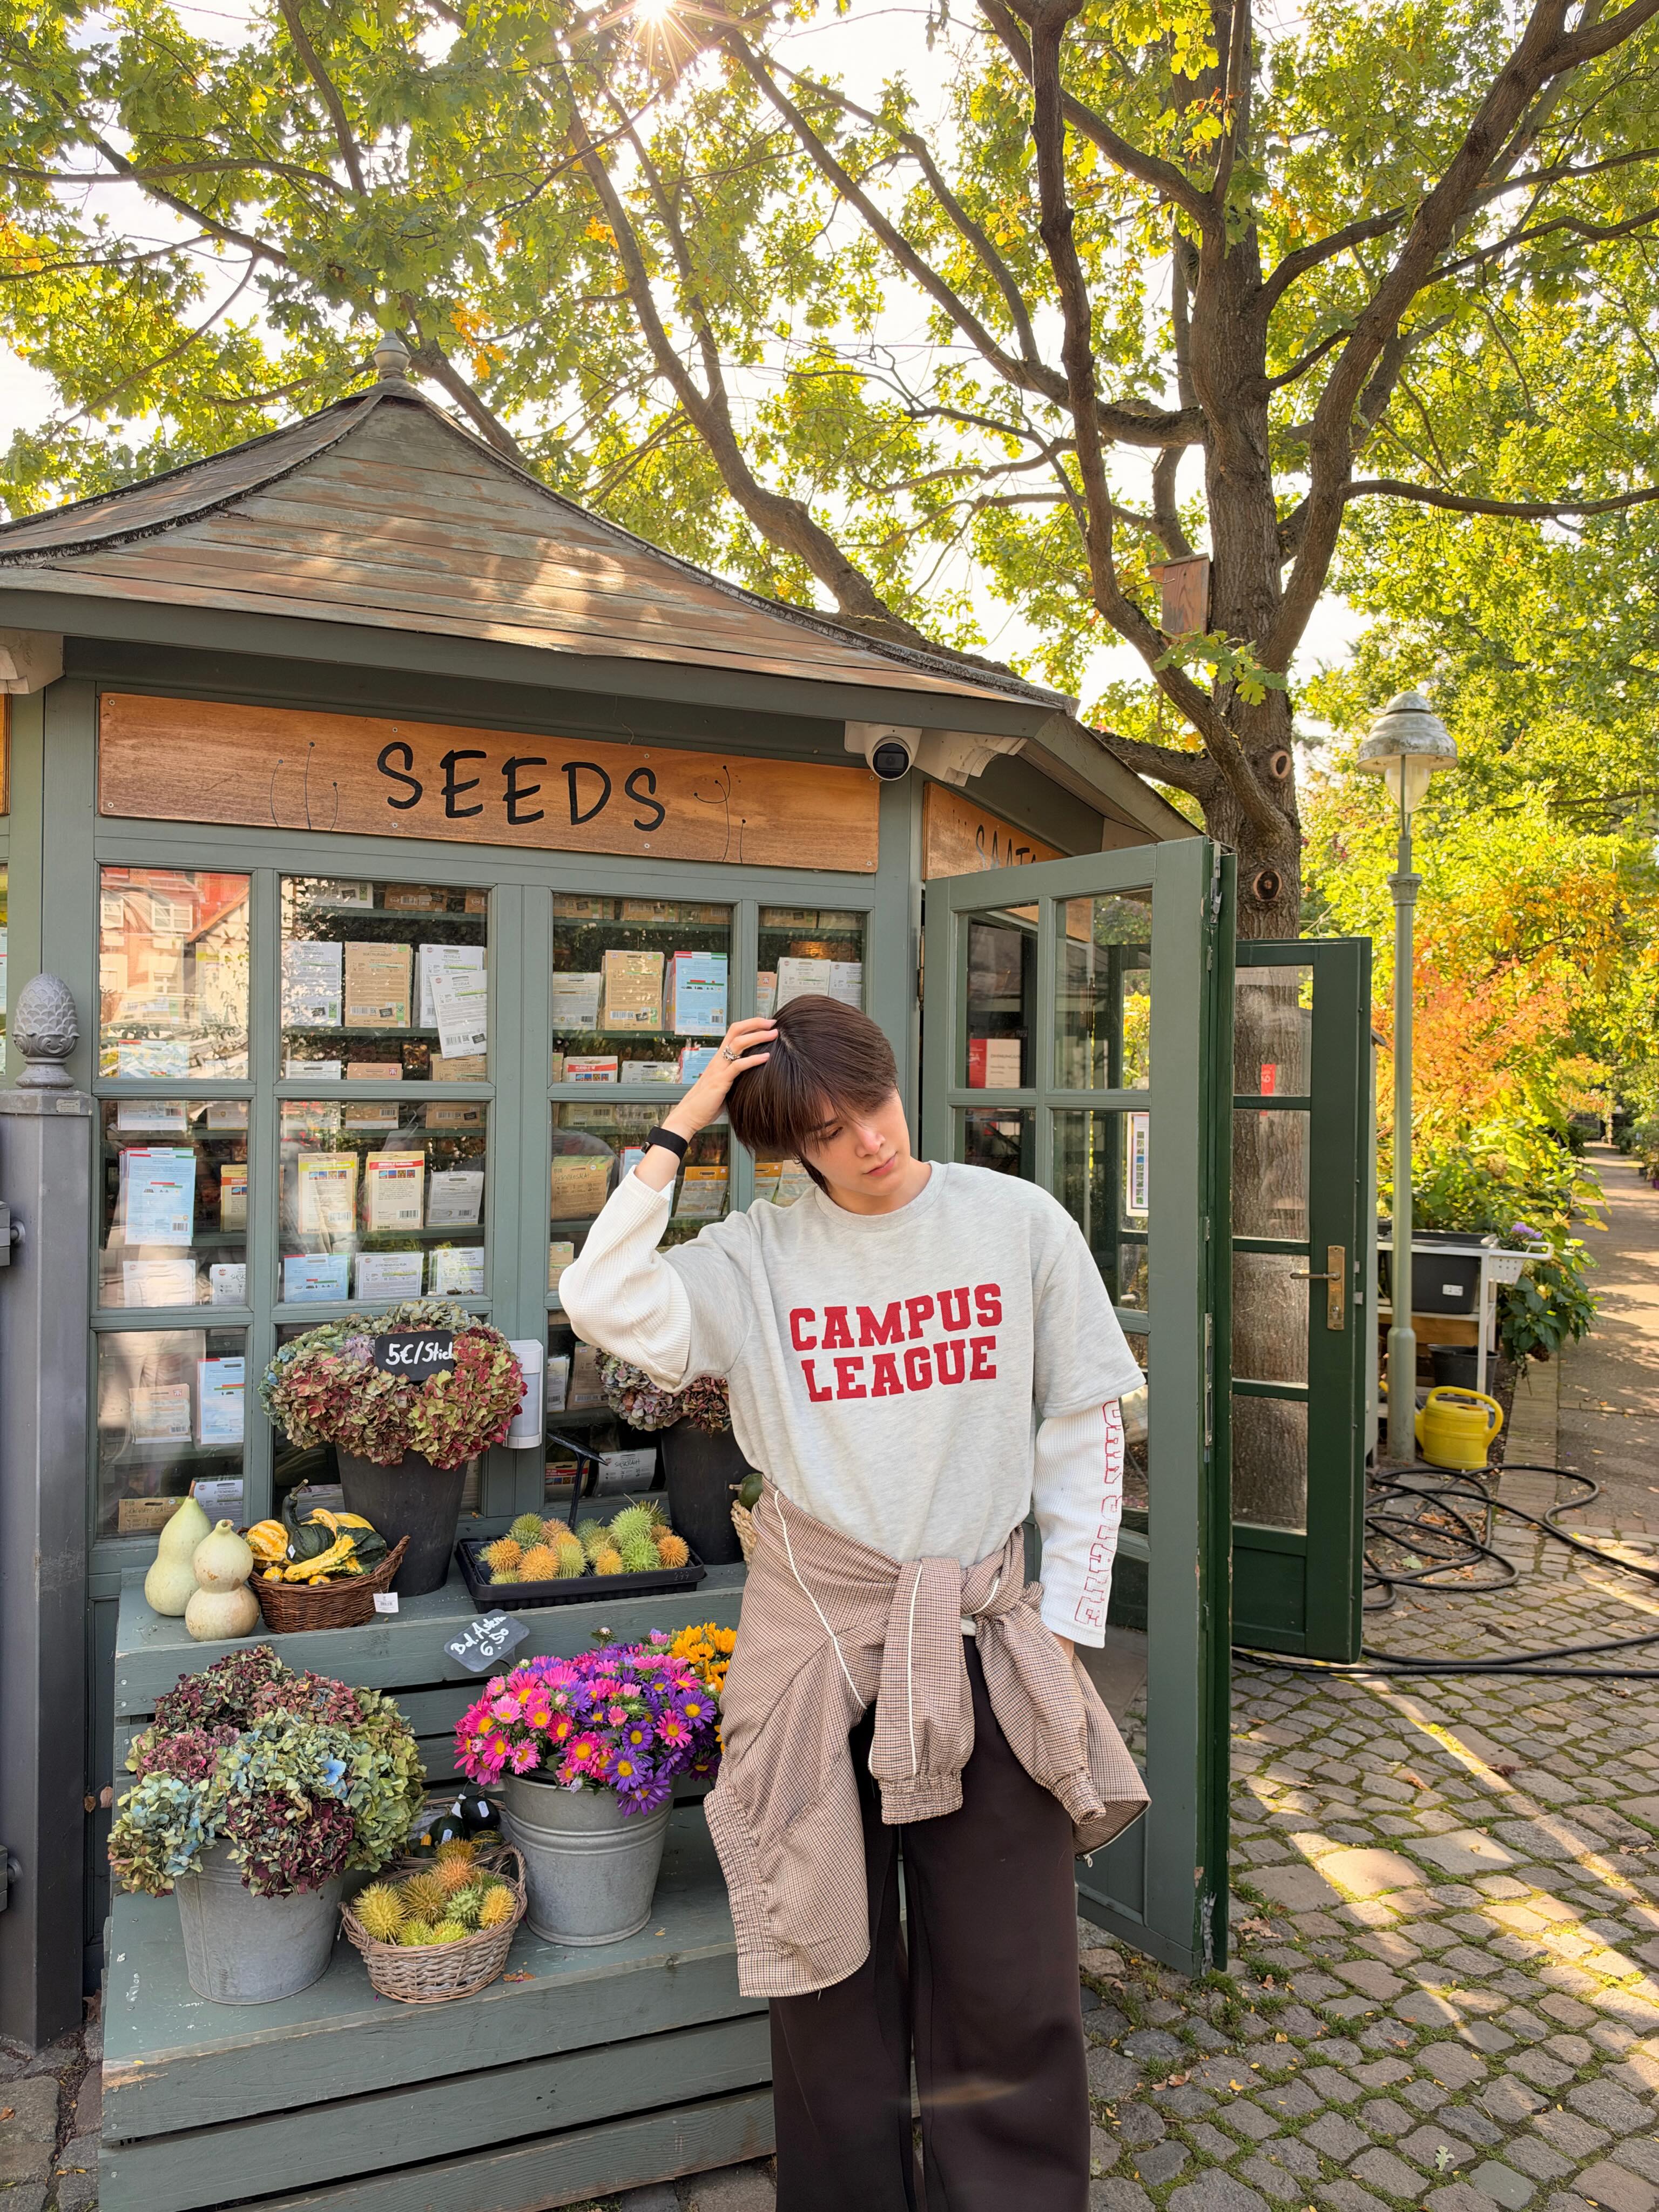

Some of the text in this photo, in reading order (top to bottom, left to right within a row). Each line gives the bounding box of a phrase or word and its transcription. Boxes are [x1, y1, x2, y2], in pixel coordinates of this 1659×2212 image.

[377, 741, 665, 832] SEEDS
[976, 825, 1036, 871] SAAT
[790, 1283, 1002, 1351] CAMPUS
[801, 1336, 996, 1402] LEAGUE
[480, 1628, 509, 1656] 6.50
